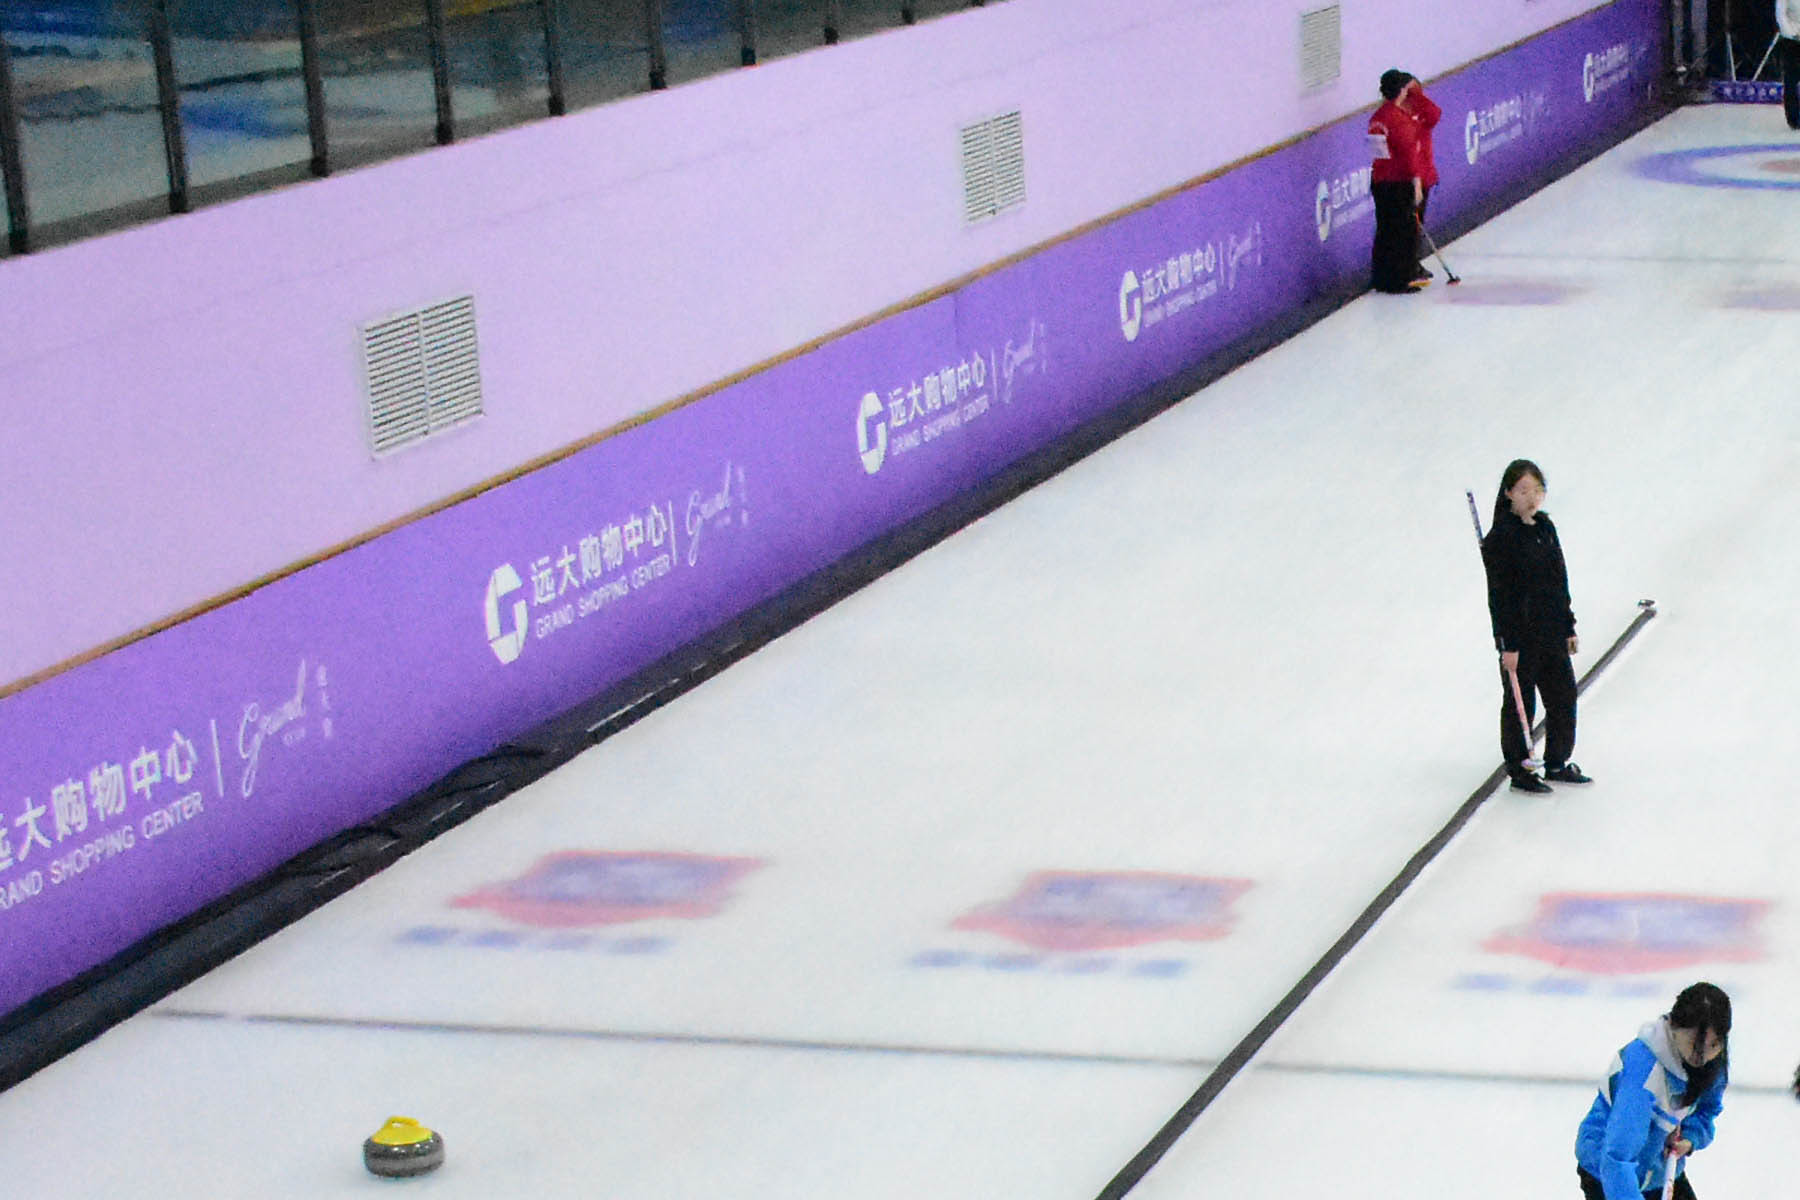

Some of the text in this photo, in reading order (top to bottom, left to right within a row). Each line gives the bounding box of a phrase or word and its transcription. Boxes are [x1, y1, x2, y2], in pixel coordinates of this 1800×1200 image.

[531, 505, 668, 606] 远大购物中心
[536, 554, 672, 639] GRAND SHOPPING CENTER
[0, 791, 205, 911] RAND SHOPPING CENTER
